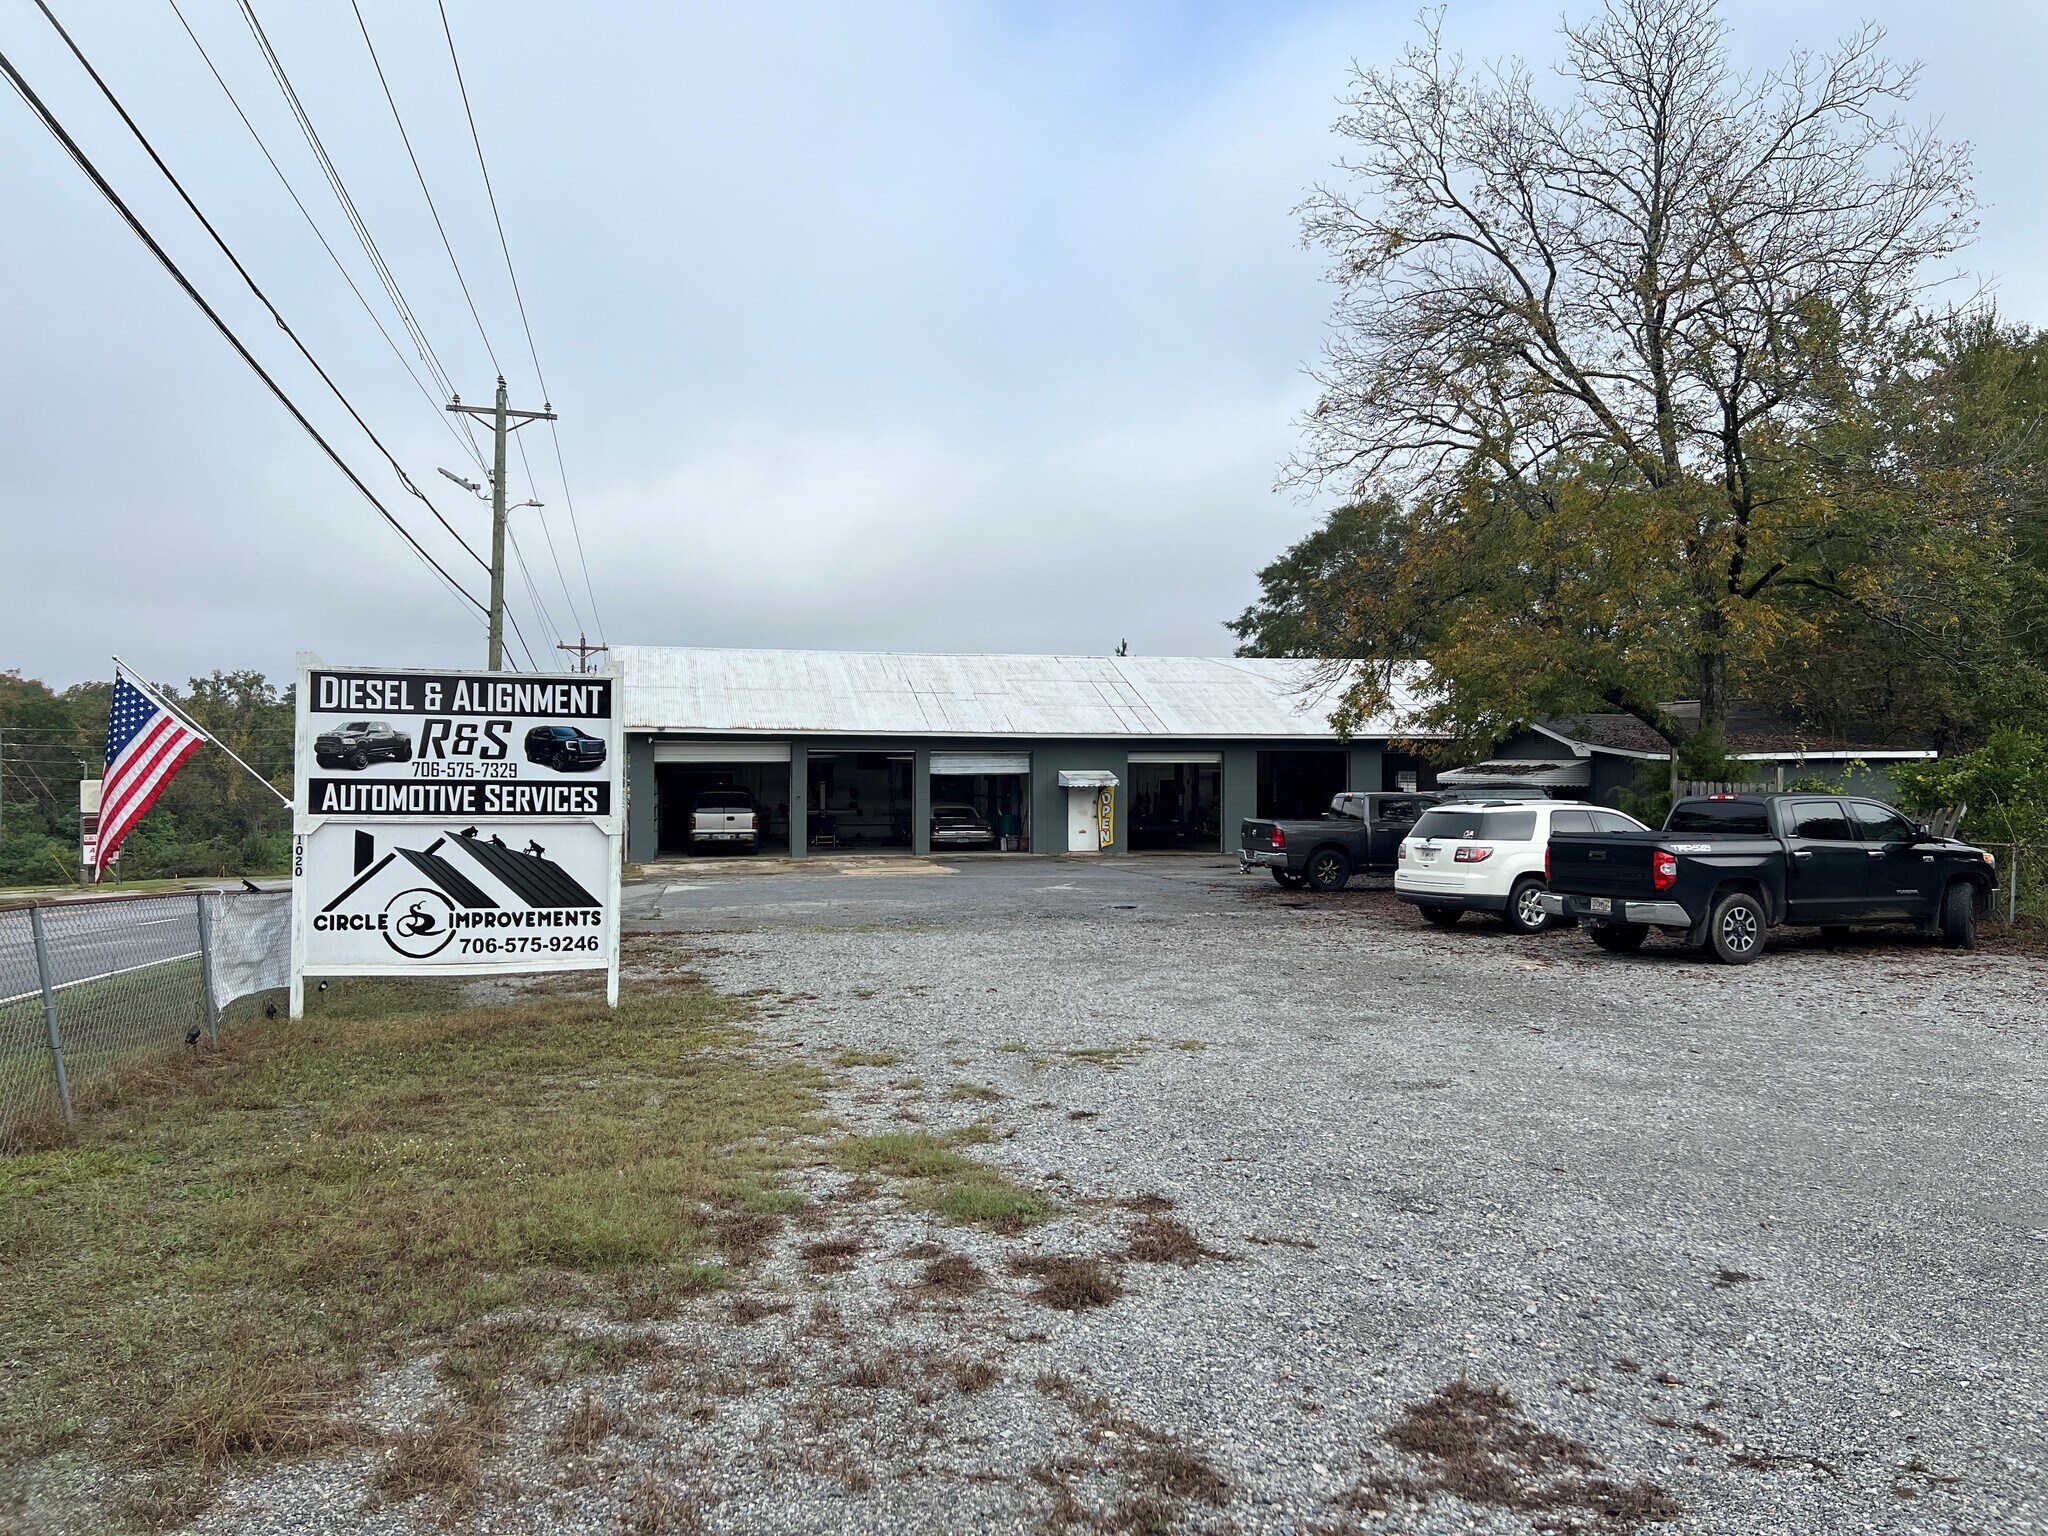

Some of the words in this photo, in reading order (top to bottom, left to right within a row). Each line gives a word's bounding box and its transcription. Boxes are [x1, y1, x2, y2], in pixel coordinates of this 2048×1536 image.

[319, 676, 414, 711] DIESEL
[424, 682, 443, 711] &
[451, 679, 603, 715] ALIGNMENT
[417, 718, 513, 760] R&S
[411, 761, 517, 778] 706-575-7329
[321, 782, 476, 812] AUTOMOTIVE
[484, 784, 598, 813] SERVICES
[1100, 791, 1113, 843] OPEN
[295, 835, 304, 877] 1020
[313, 913, 389, 932] CIRCLE
[448, 910, 601, 929] IMPROVEMENTS
[459, 935, 599, 954] 706-575-9246
